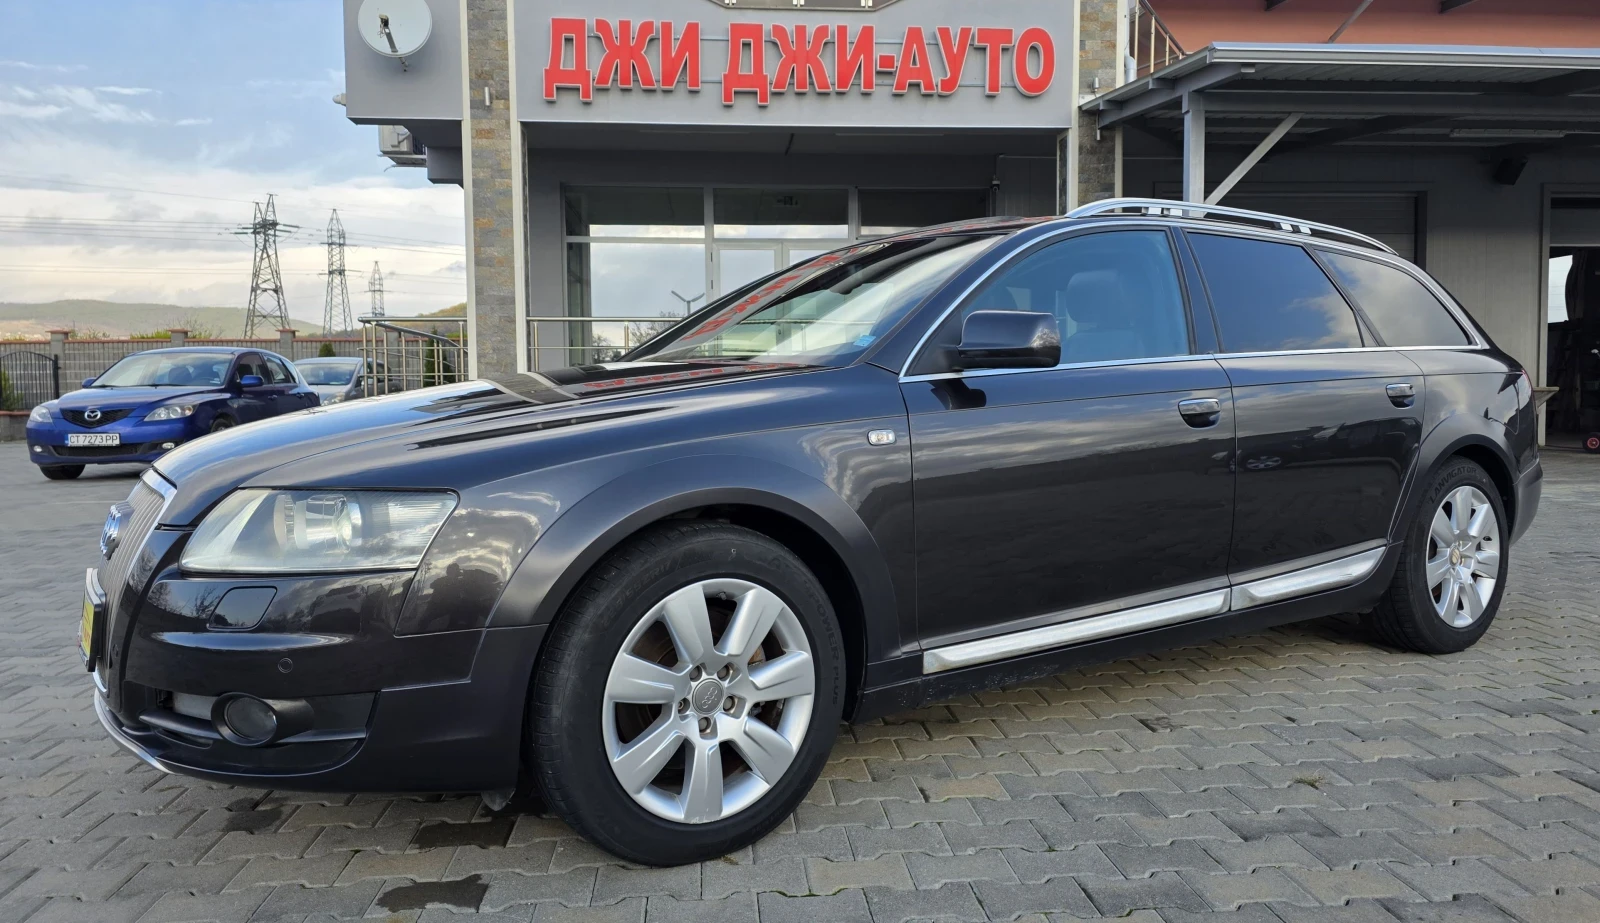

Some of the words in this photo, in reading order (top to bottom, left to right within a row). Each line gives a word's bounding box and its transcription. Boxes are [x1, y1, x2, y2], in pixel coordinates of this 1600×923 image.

[543, 18, 701, 102] ДЖИ
[722, 22, 1056, 107] ДЖИ-АУТО
[69, 435, 80, 444] CT
[82, 435, 104, 444] 7273
[105, 435, 118, 444] PP
[1430, 466, 1476, 503] LANVIGATOR
